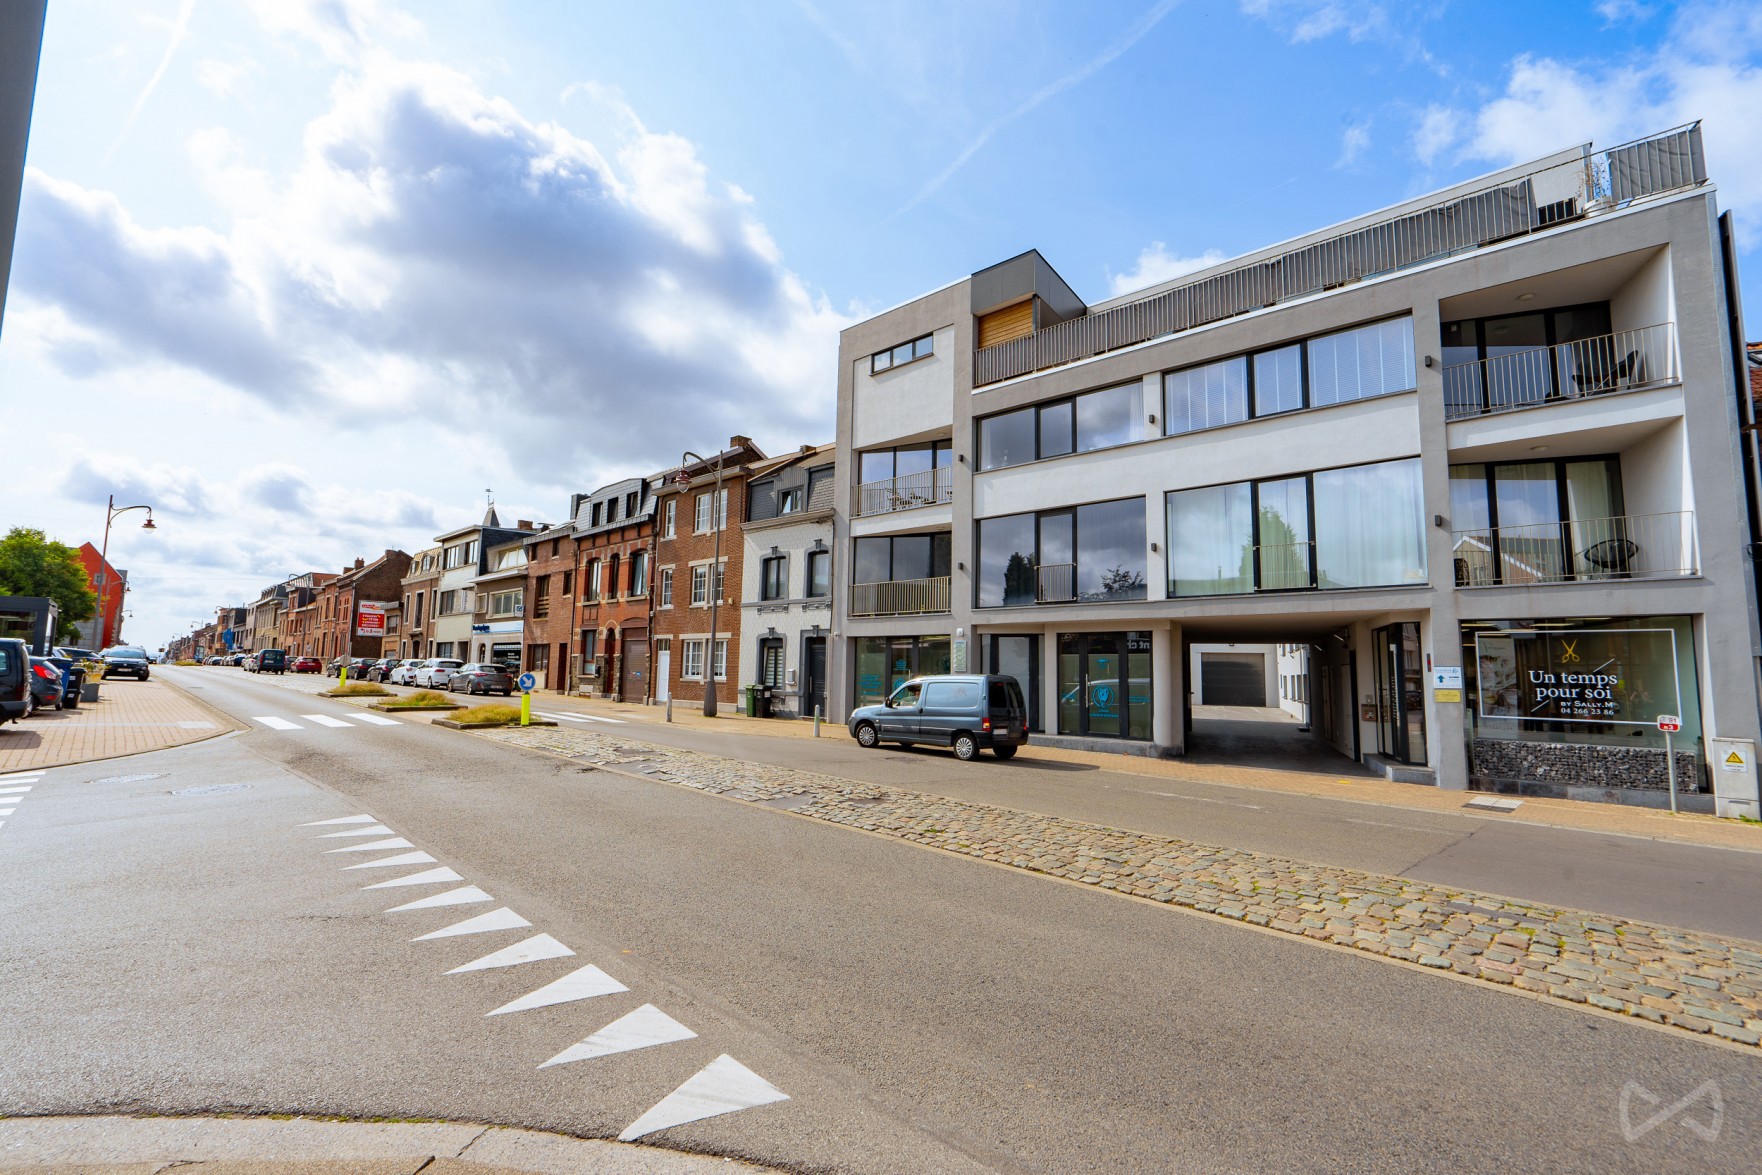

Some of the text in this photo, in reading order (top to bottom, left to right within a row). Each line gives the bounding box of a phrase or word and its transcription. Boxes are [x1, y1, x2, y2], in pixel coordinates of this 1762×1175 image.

[1528, 670, 1618, 688] Un temps
[1536, 686, 1612, 701] pour soi
